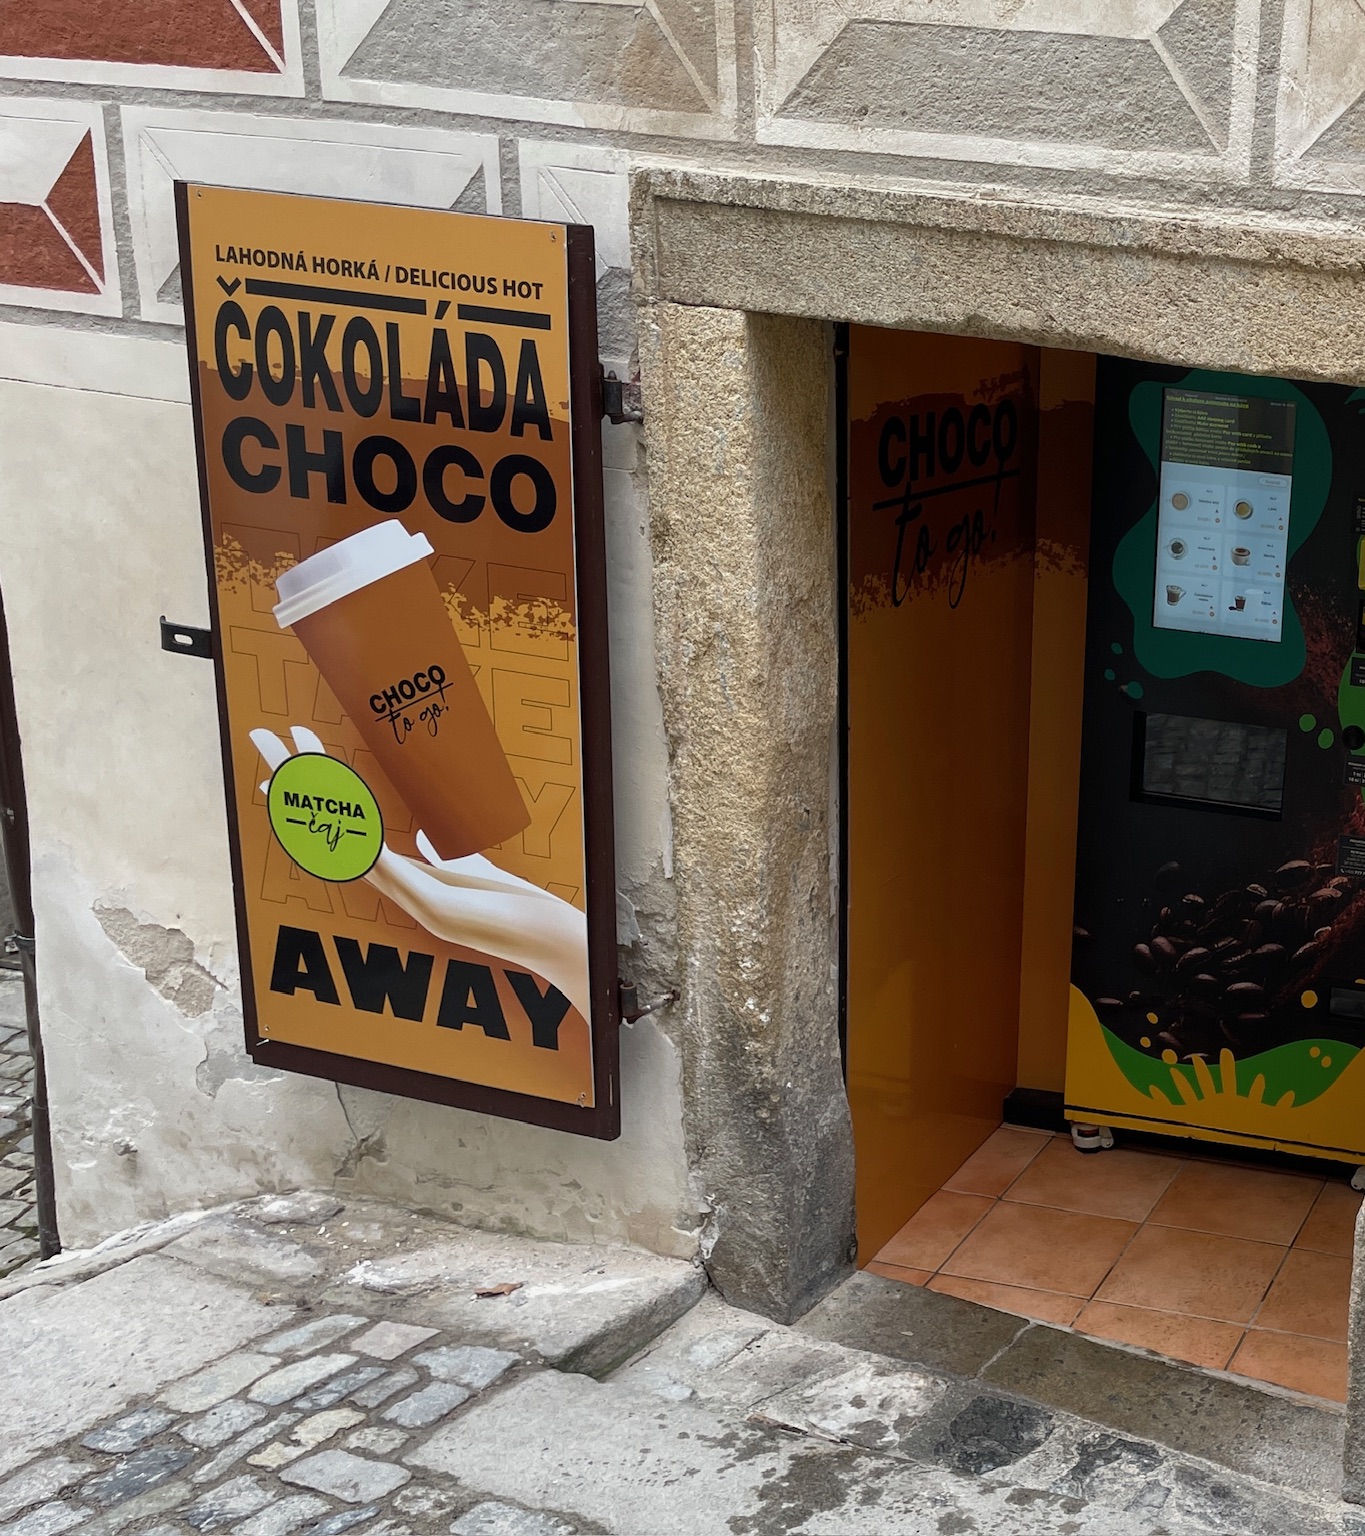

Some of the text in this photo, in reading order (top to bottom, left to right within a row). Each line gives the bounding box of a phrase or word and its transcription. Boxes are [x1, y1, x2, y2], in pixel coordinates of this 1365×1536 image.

[215, 244, 544, 300] LAHODNÁ HORKÁ / DELICIOUS HOT
[214, 274, 555, 442] ČOKOLÁDA
[221, 416, 557, 534] CHOCO
[878, 398, 1019, 488] CHOCO
[891, 480, 938, 608] to
[369, 664, 447, 714] CHOCO
[388, 706, 416, 745] to
[283, 791, 366, 820] MATCHA
[308, 811, 345, 852] čaj
[270, 924, 573, 1051] AWAY
